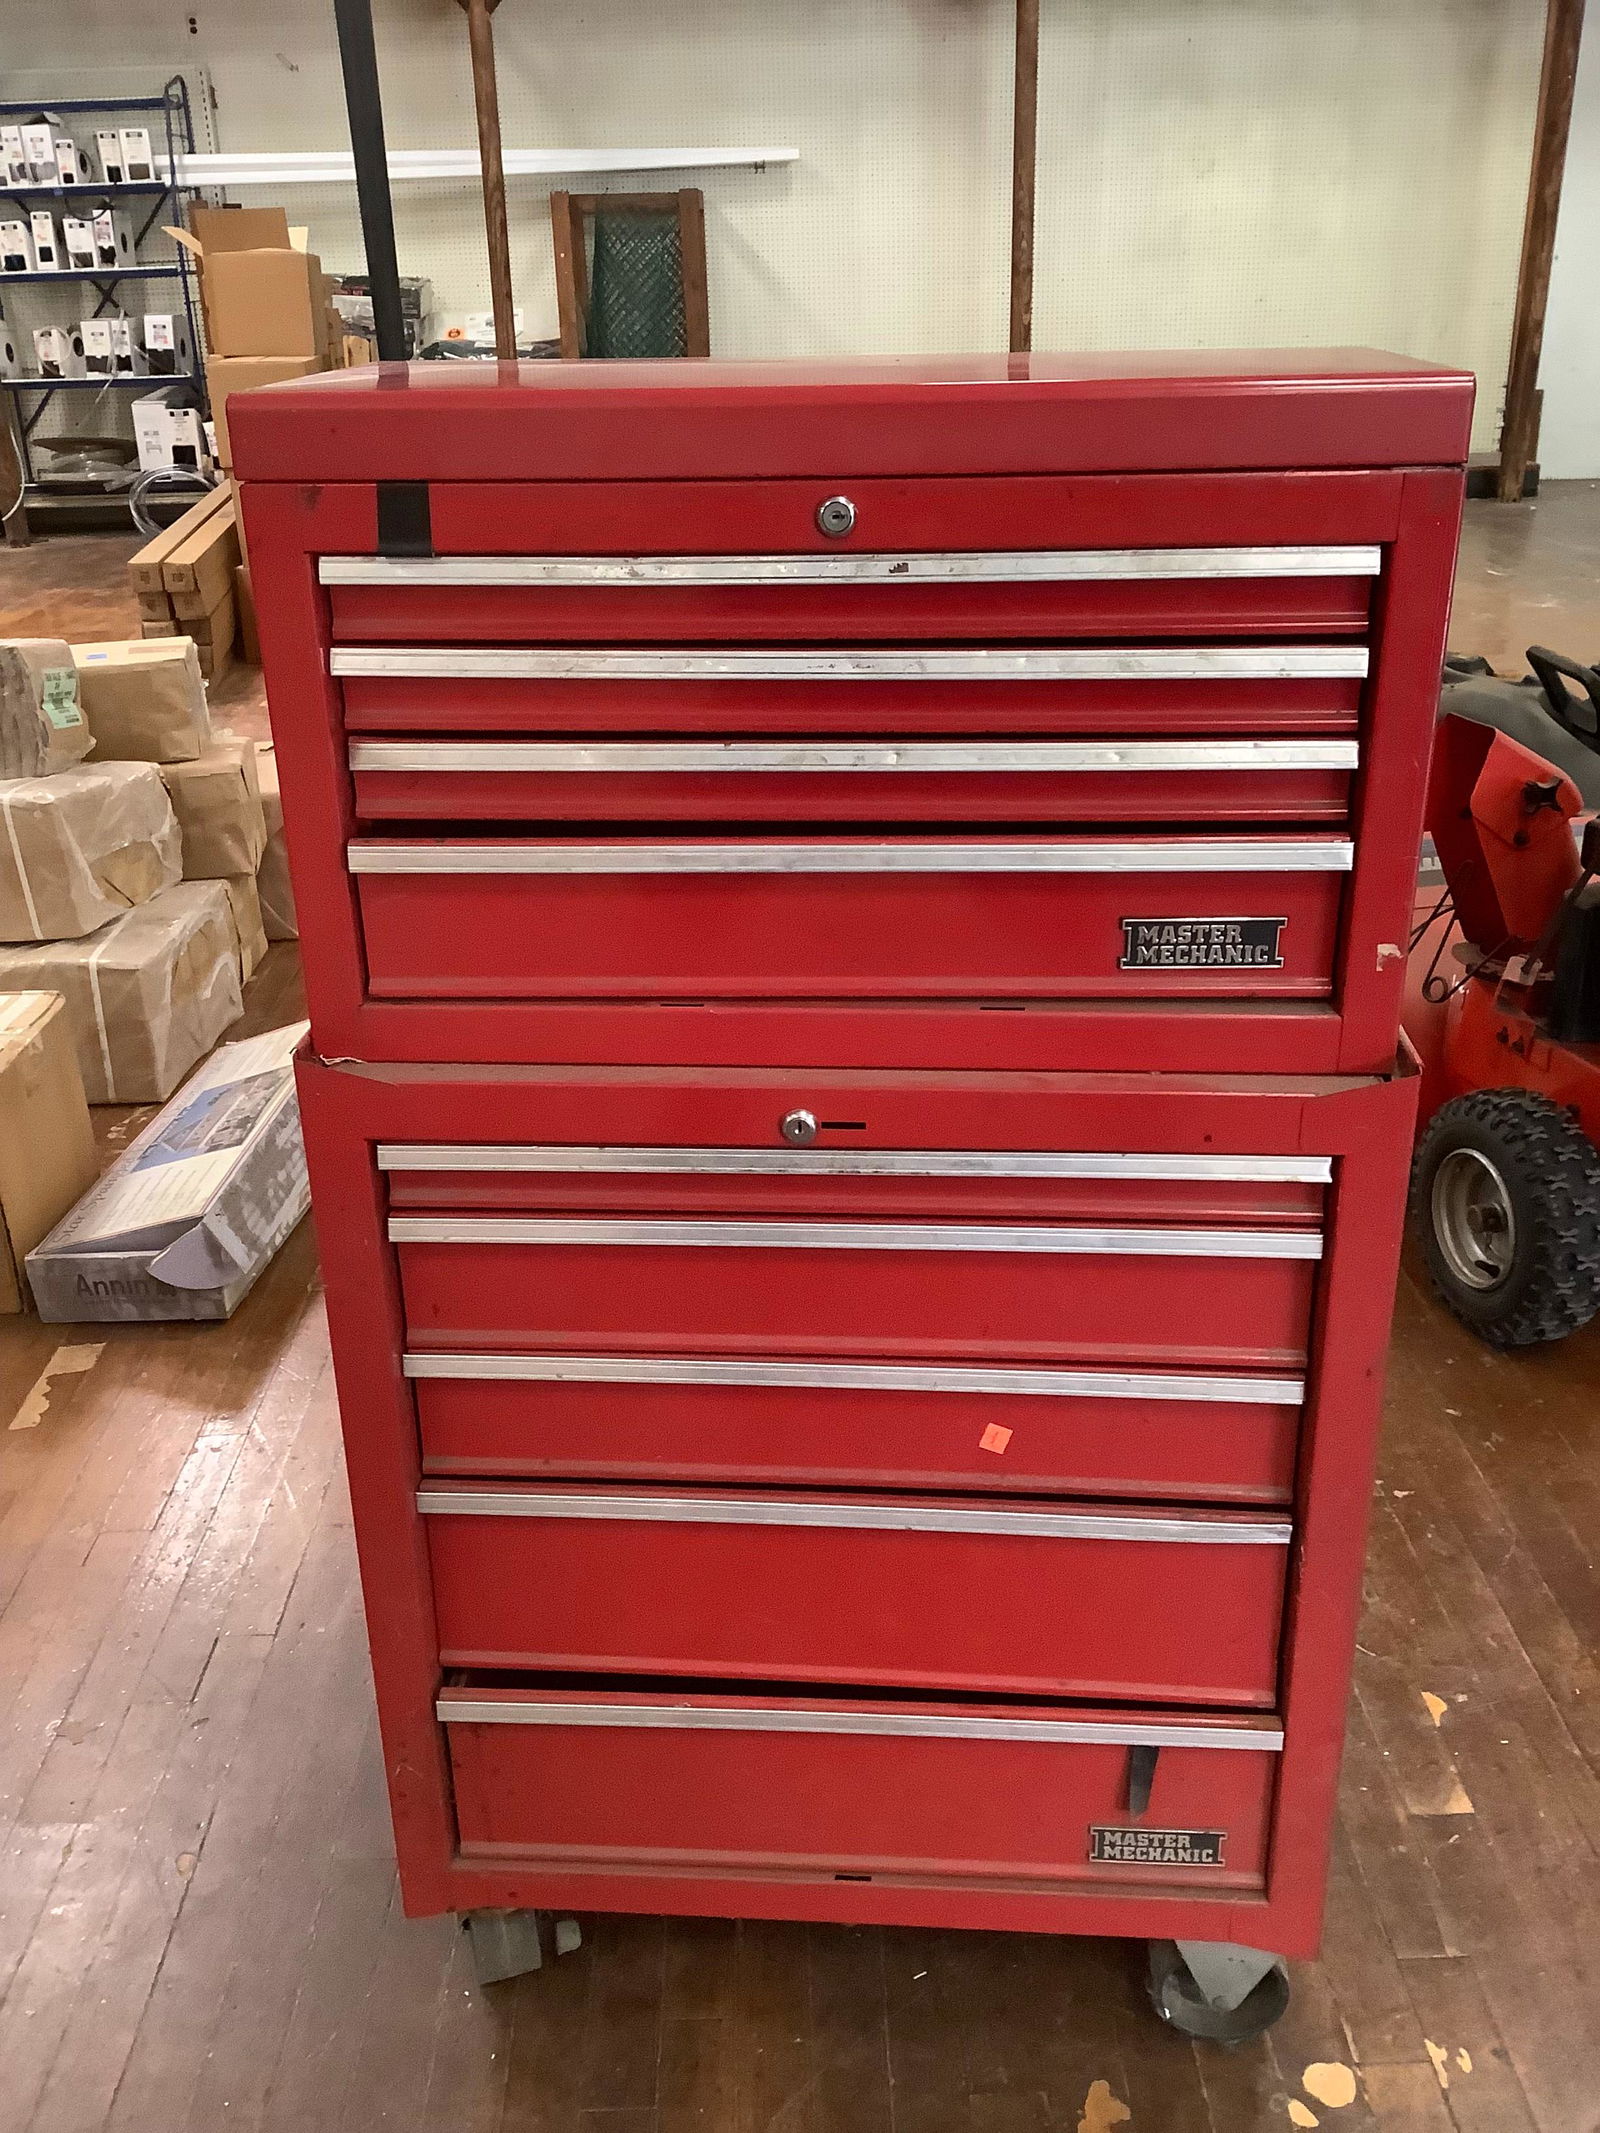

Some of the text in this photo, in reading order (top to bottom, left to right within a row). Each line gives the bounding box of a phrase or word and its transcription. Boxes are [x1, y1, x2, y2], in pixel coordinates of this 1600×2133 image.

[1138, 924, 1242, 943] MASTER
[1136, 945, 1269, 964] MECHANIC
[1103, 1833, 1191, 1848] MASTER
[1103, 1847, 1213, 1862] MECHANIC
